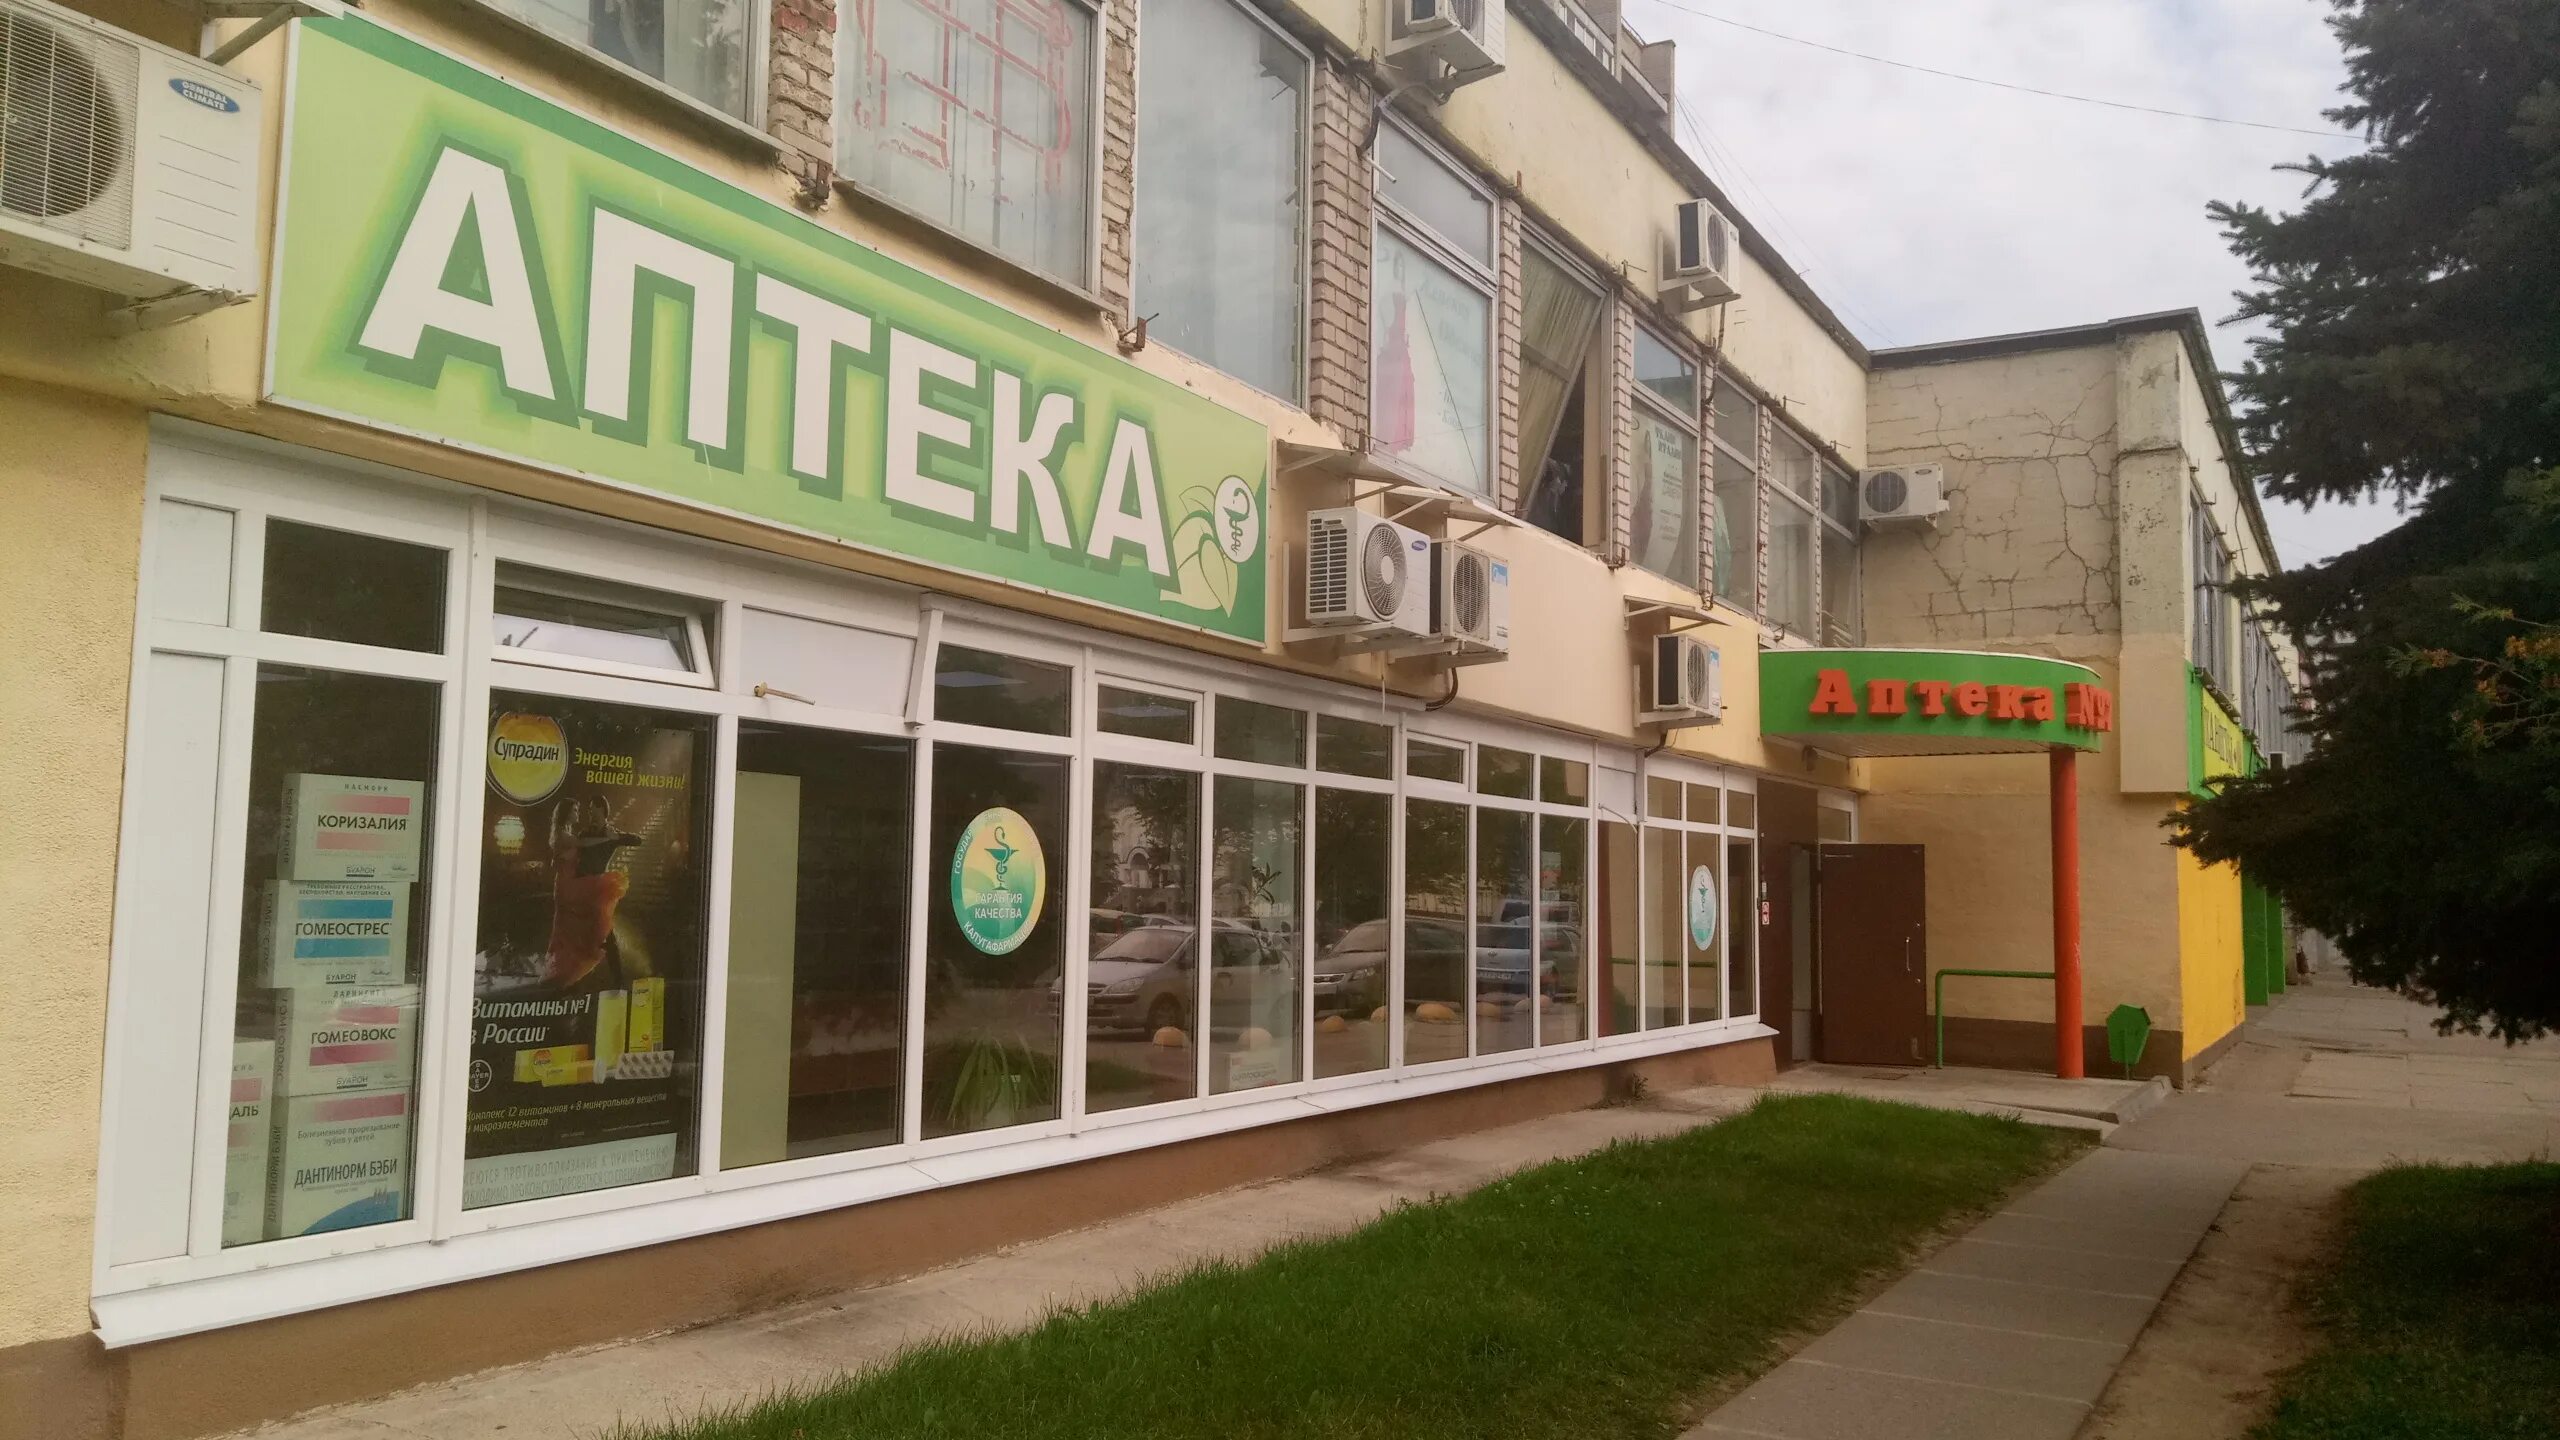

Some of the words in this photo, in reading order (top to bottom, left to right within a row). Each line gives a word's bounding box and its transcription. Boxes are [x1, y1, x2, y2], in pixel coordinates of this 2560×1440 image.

[182, 81, 228, 104] GENERAL
[182, 89, 225, 111] CLIMATE
[357, 145, 1177, 579] АПТЕКА
[1809, 668, 2054, 720] Аптека
[494, 736, 559, 762] Супрадин
[573, 747, 633, 770] Энергия
[586, 770, 633, 786] вашей
[636, 773, 686, 790] жизни!
[317, 814, 407, 831] КОРИЗАЛИЯ
[975, 892, 1023, 904] ГАРАНТИЯ
[974, 907, 1022, 919] КАЧЕСТВА
[295, 922, 389, 936] ГОМЕОСТРЕС
[325, 973, 356, 981] БУАРОН
[471, 997, 569, 1018] Витамины
[570, 993, 591, 1015] №1
[311, 1027, 397, 1045] ГОМЕОВОКС
[508, 1106, 518, 1117] 12
[518, 1104, 568, 1117] витаминов
[576, 1100, 582, 1111] 8
[583, 1096, 636, 1110] минеральных
[473, 1118, 548, 1133] микроэлементов
[294, 1163, 367, 1188] ДАНТИНОРМ
[369, 1158, 398, 1177] БЭБИ
